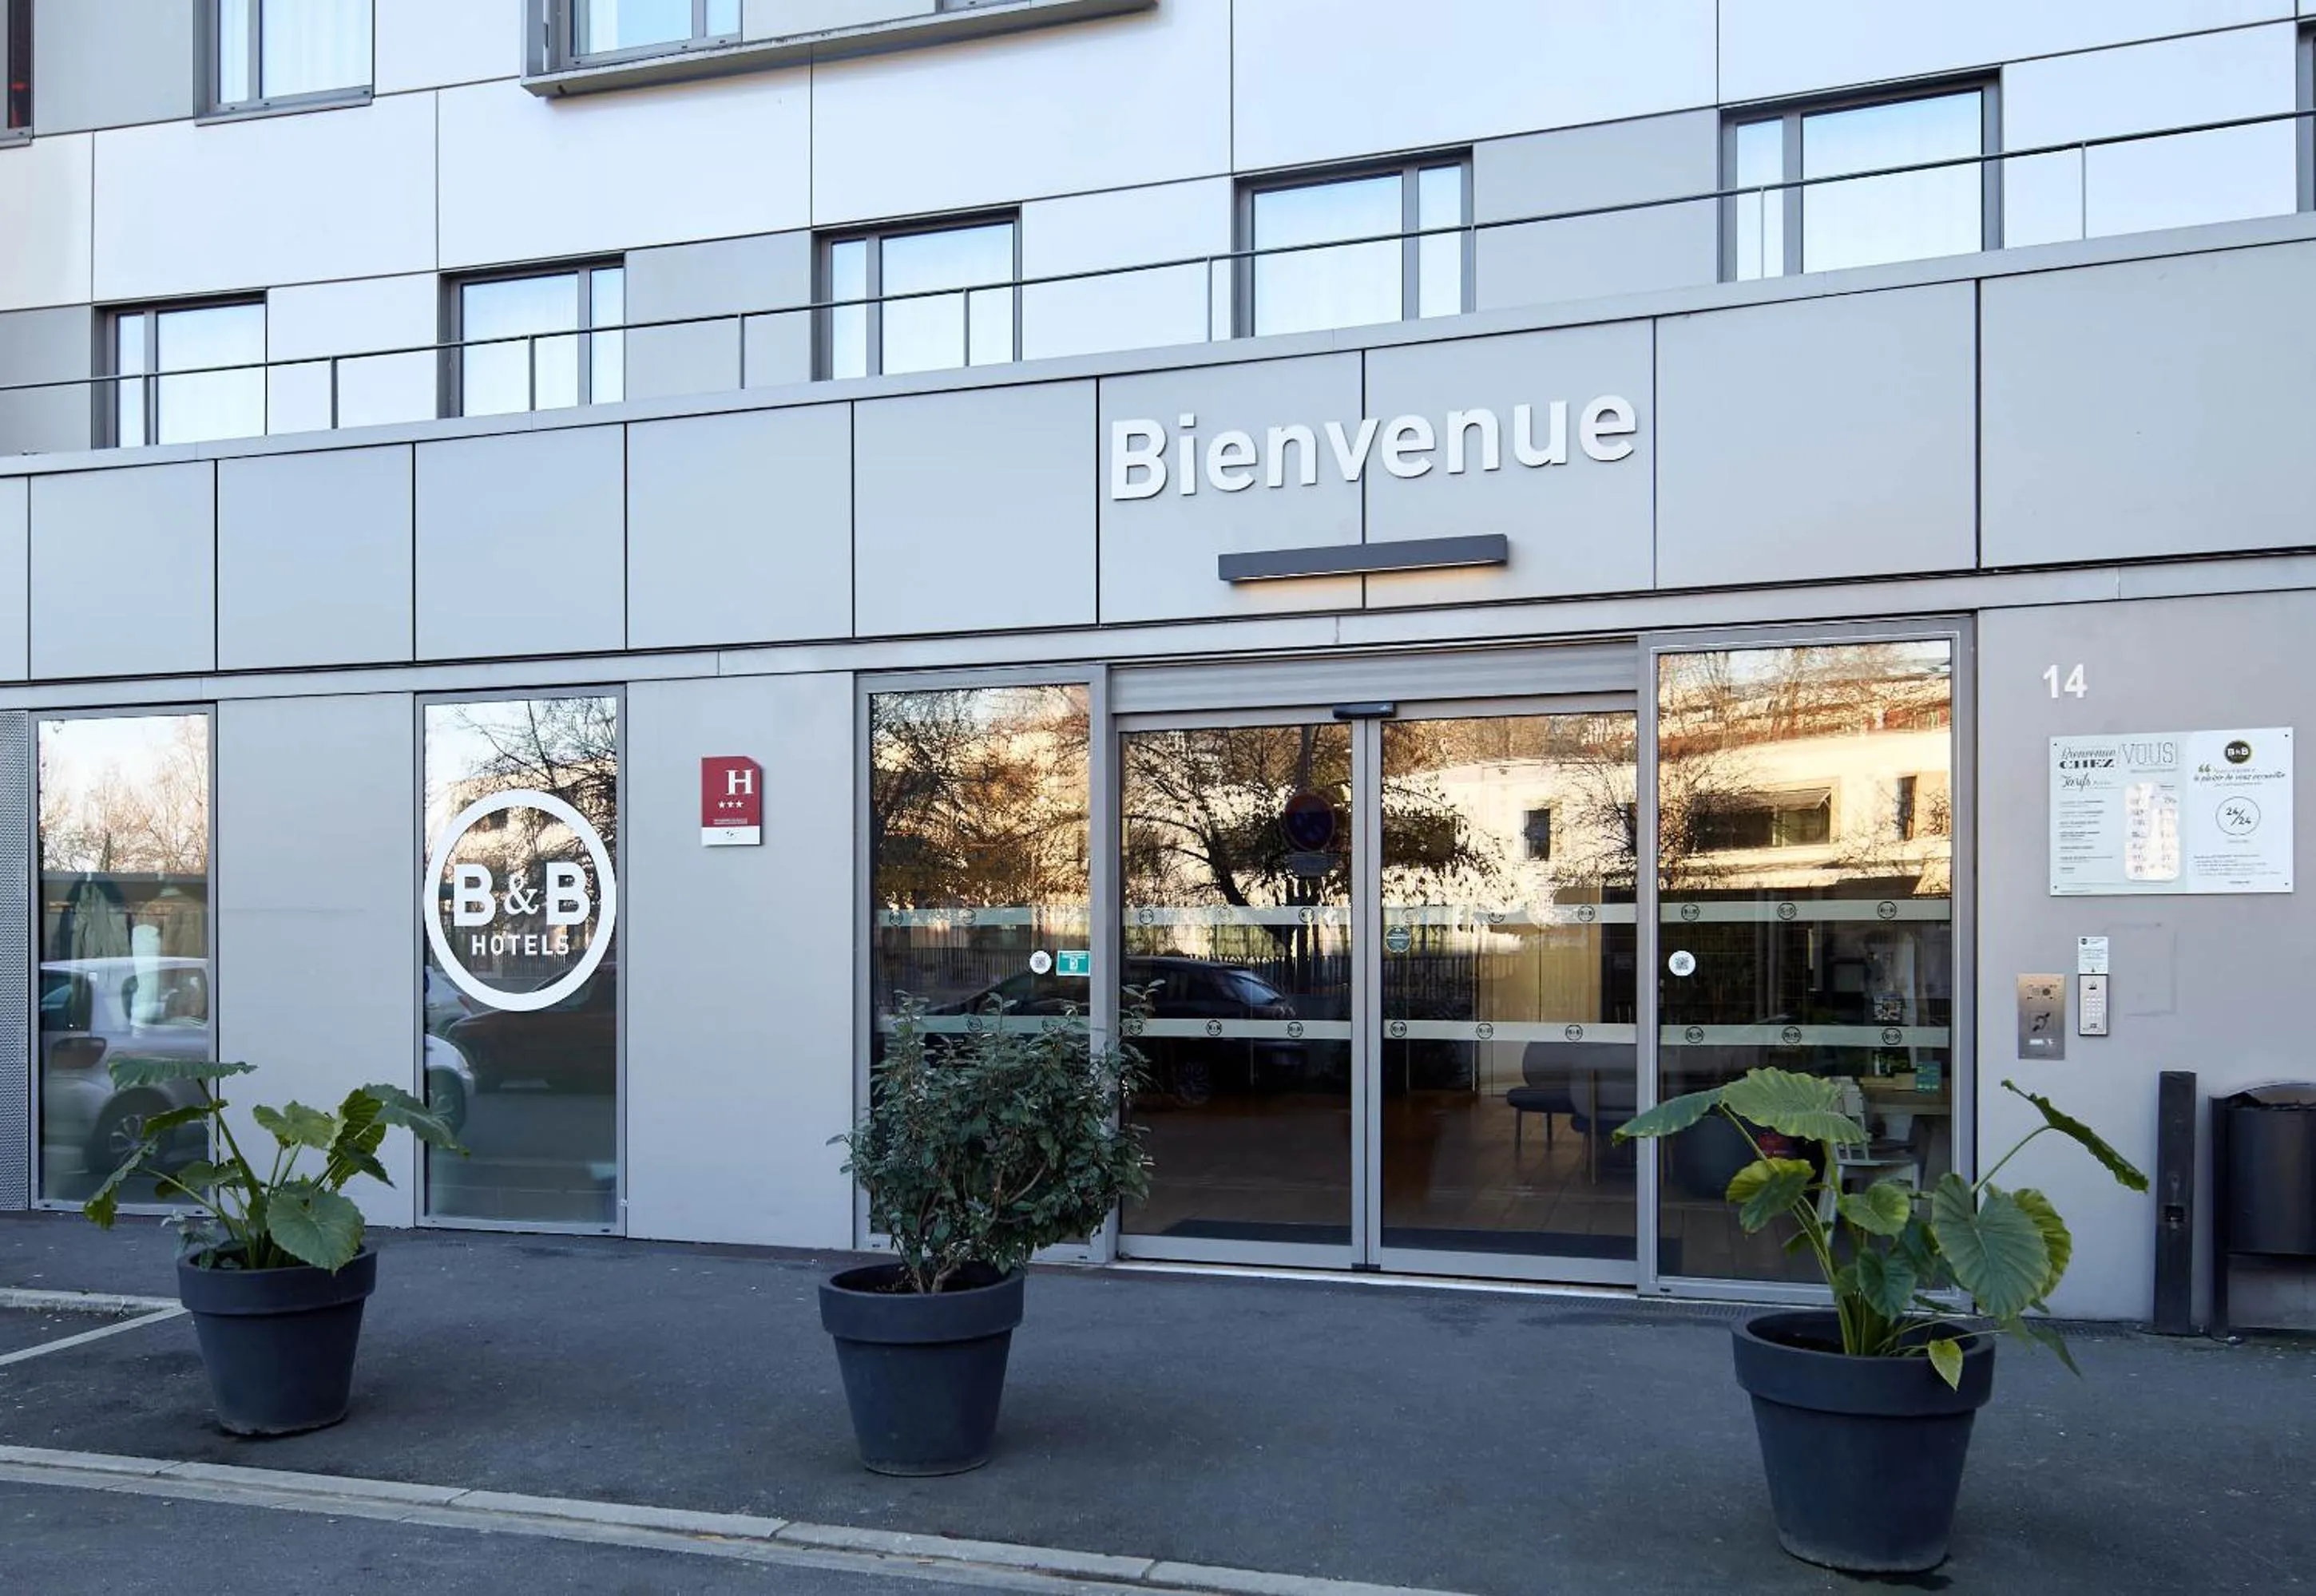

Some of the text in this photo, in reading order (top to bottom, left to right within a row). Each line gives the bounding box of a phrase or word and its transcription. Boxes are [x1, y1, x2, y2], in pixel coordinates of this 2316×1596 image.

[1111, 394, 1636, 501] Bienvenue
[2043, 664, 2088, 699] 14
[2121, 742, 2174, 765] VOUS
[725, 769, 754, 796] H
[454, 861, 591, 927] B&B
[471, 934, 569, 956] HOTELS
